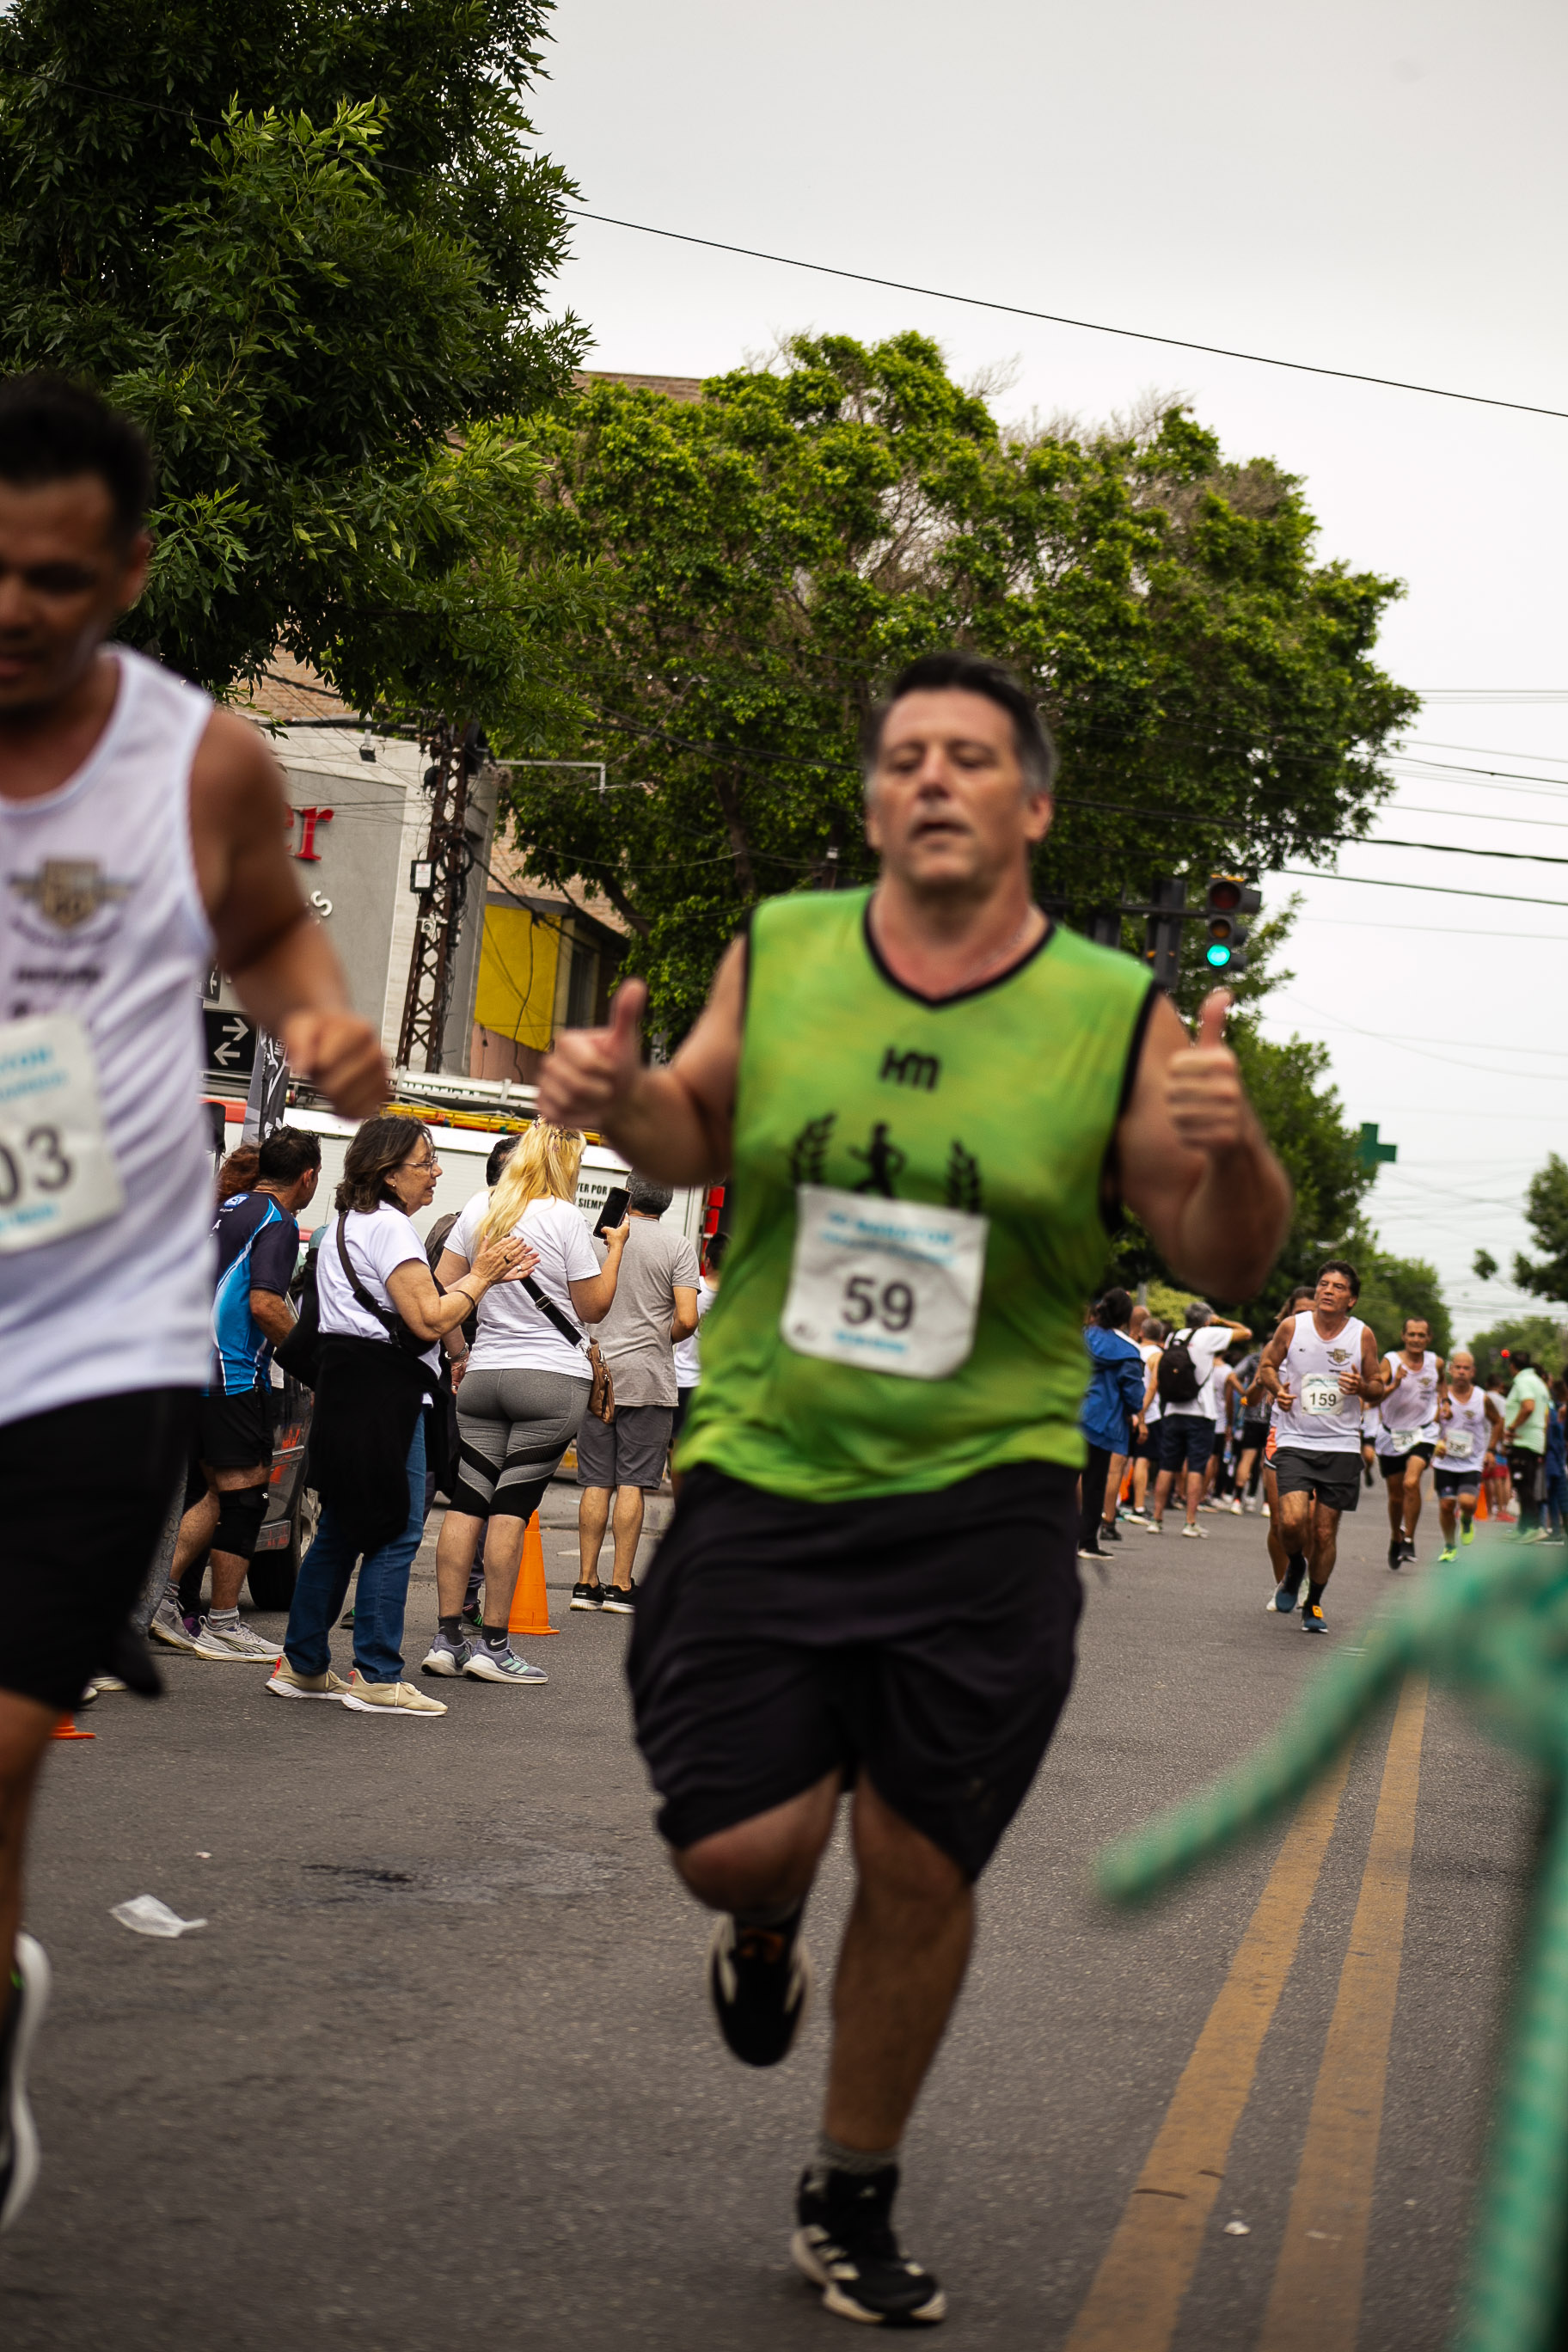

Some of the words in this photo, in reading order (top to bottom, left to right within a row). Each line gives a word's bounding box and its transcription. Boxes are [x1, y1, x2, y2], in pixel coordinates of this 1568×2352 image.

[591, 1184, 608, 1196] POR
[841, 1274, 916, 1332] 59
[1309, 1392, 1337, 1407] 159
